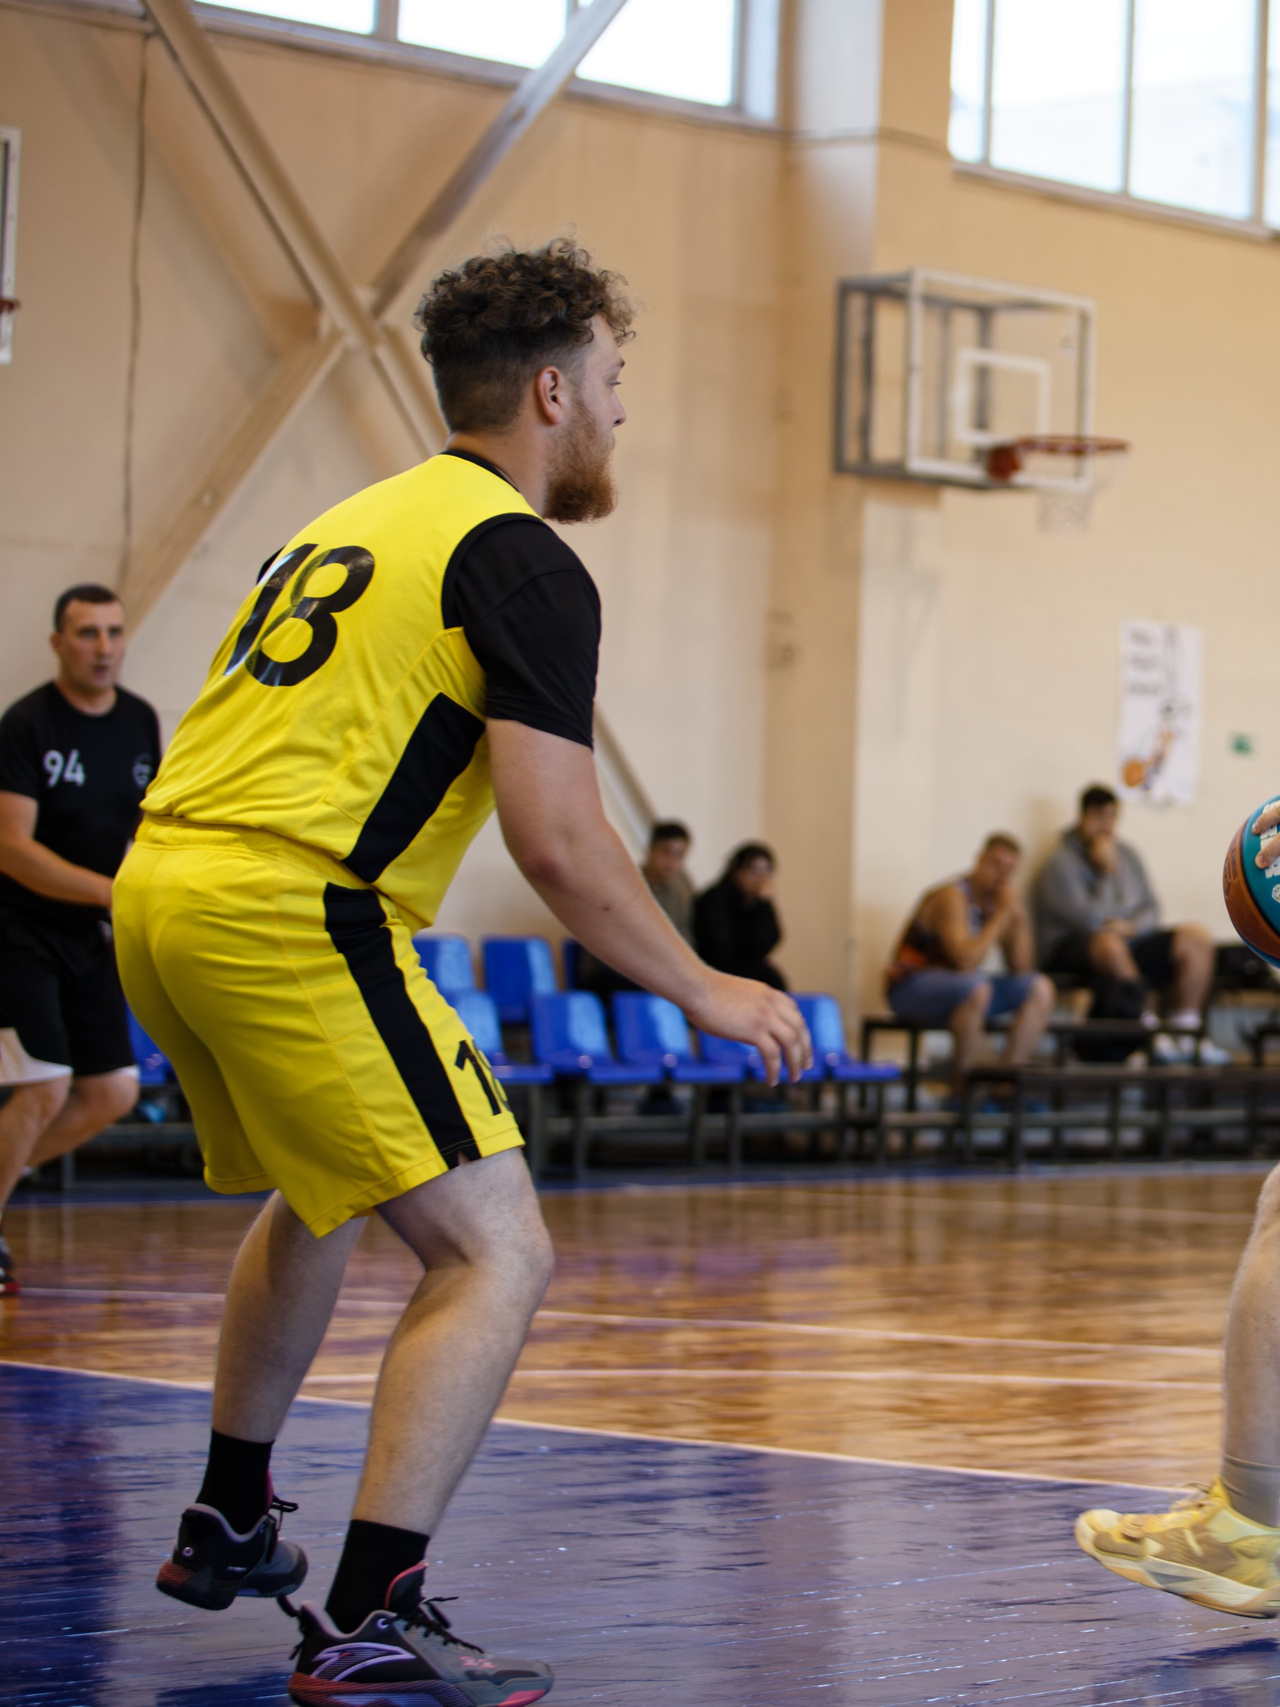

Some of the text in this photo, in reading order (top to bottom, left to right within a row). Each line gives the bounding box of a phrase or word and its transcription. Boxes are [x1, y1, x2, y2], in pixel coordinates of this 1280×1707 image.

[223, 543, 375, 687] 18
[43, 749, 85, 787] 94
[454, 1039, 512, 1117] 1
